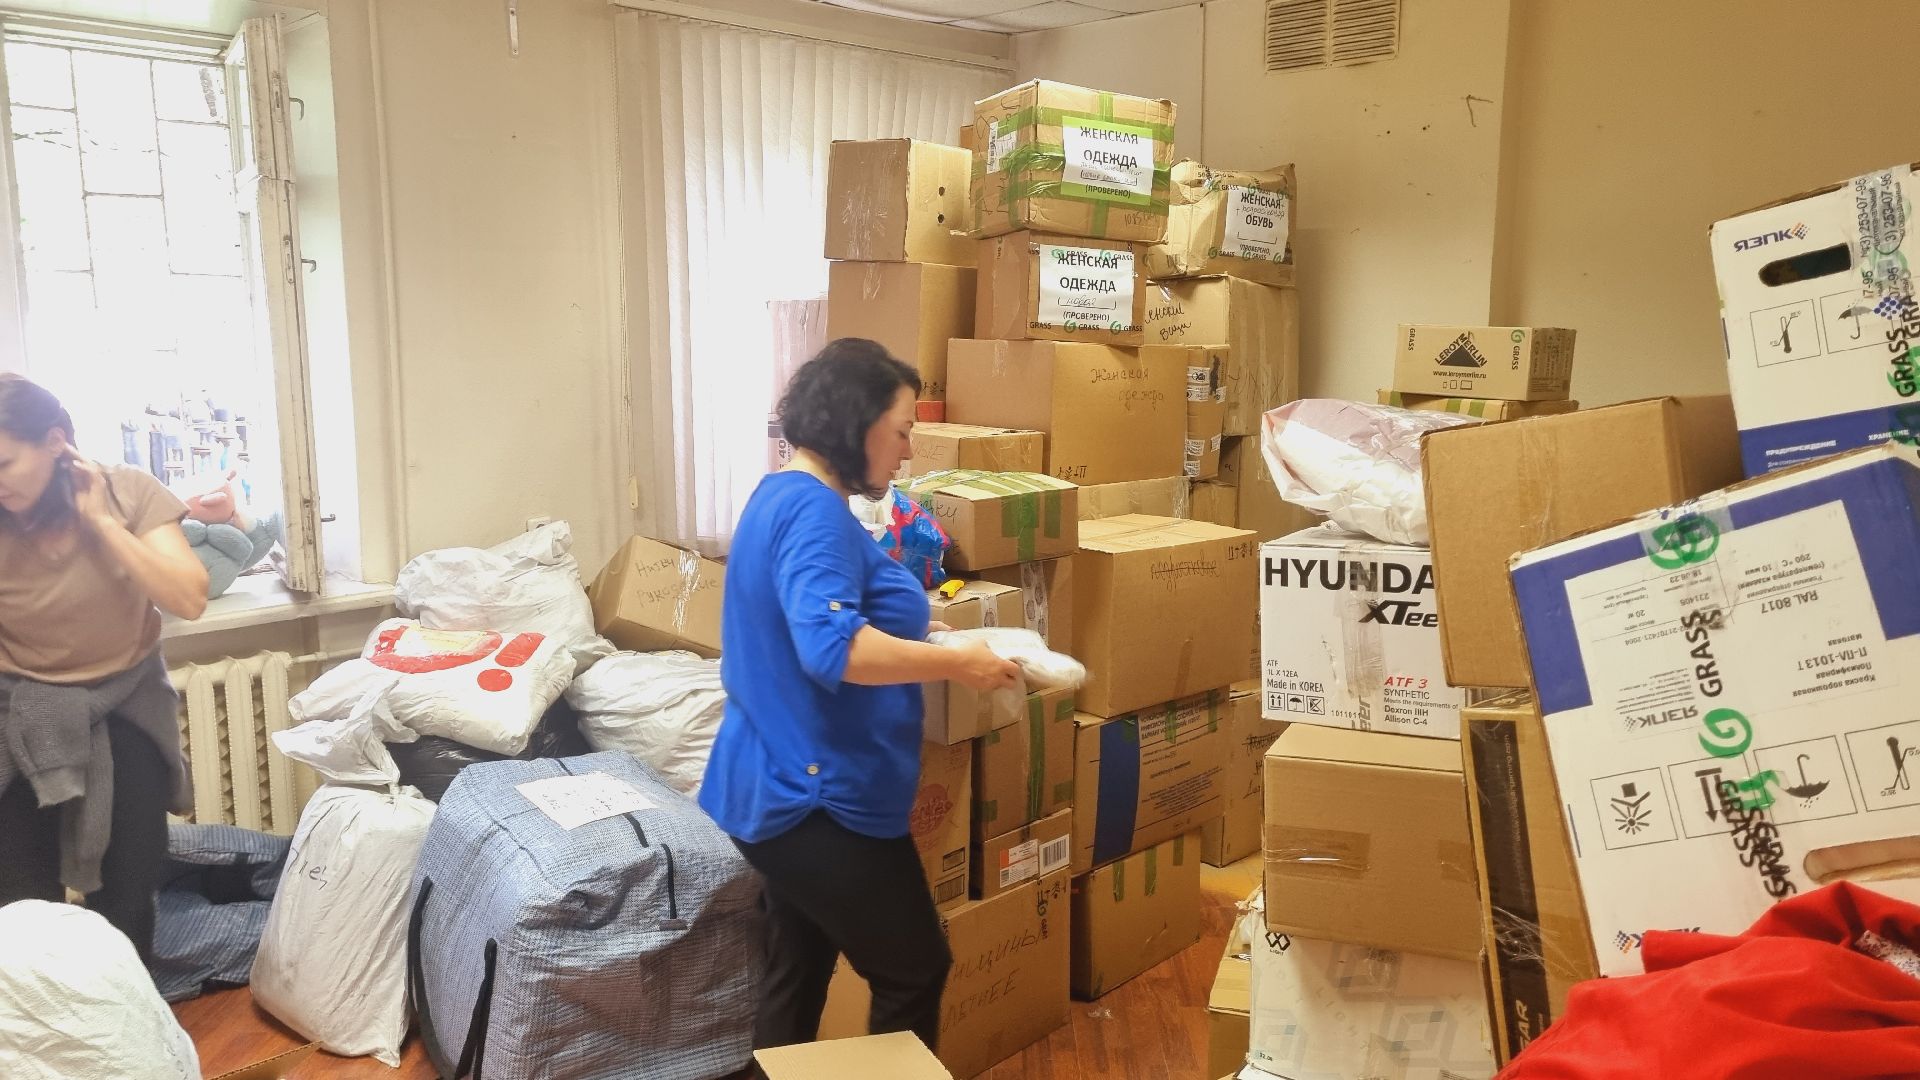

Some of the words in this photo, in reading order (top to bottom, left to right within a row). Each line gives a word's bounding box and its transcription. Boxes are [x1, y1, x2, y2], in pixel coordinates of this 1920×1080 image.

[1080, 126, 1138, 144] ЖЕНСКАЯ
[1084, 150, 1137, 168] ОДЕЖДА
[1085, 184, 1131, 198] (ПРОВЕРЕНО)
[1240, 192, 1281, 209] ЖЕНСКАЯ
[1246, 215, 1273, 229] ОБУВЬ
[1058, 253, 1118, 269] ЖЕНСКАЯ
[1060, 277, 1116, 293] ОДЕЖДА
[1063, 311, 1110, 321] (ПРОВЕРЕНО)
[1029, 321, 1051, 330] GRASS
[1434, 339, 1461, 365] LEROY
[1458, 331, 1488, 367] MERLIN
[1511, 345, 1520, 370] GRASS
[1886, 327, 1916, 397] GRASS
[1433, 371, 1487, 379] www.leroymerlin.ru
[1265, 557, 1435, 594] HYUNDA
[1760, 595, 1792, 614] 8017
[1793, 590, 1820, 606] RAL
[1359, 600, 1438, 627] XTee
[1635, 609, 1646, 618] 20
[1828, 633, 1863, 646] матовая
[1282, 670, 1298, 678] 12EA
[1815, 662, 1872, 680] Полиэфирная
[1266, 678, 1287, 689] Made
[1289, 679, 1297, 690] in
[1299, 681, 1324, 693] KOREA
[1384, 676, 1415, 688] ATF
[1418, 678, 1428, 688] 3
[1791, 680, 1838, 697] порошковая
[1840, 673, 1876, 689] Краска
[1384, 688, 1430, 699] SYNTHETIC
[1384, 705, 1412, 715] Dexron
[1413, 700, 1451, 709] requirements
[1384, 715, 1411, 724] Allison
[1413, 717, 1428, 726] C-4
